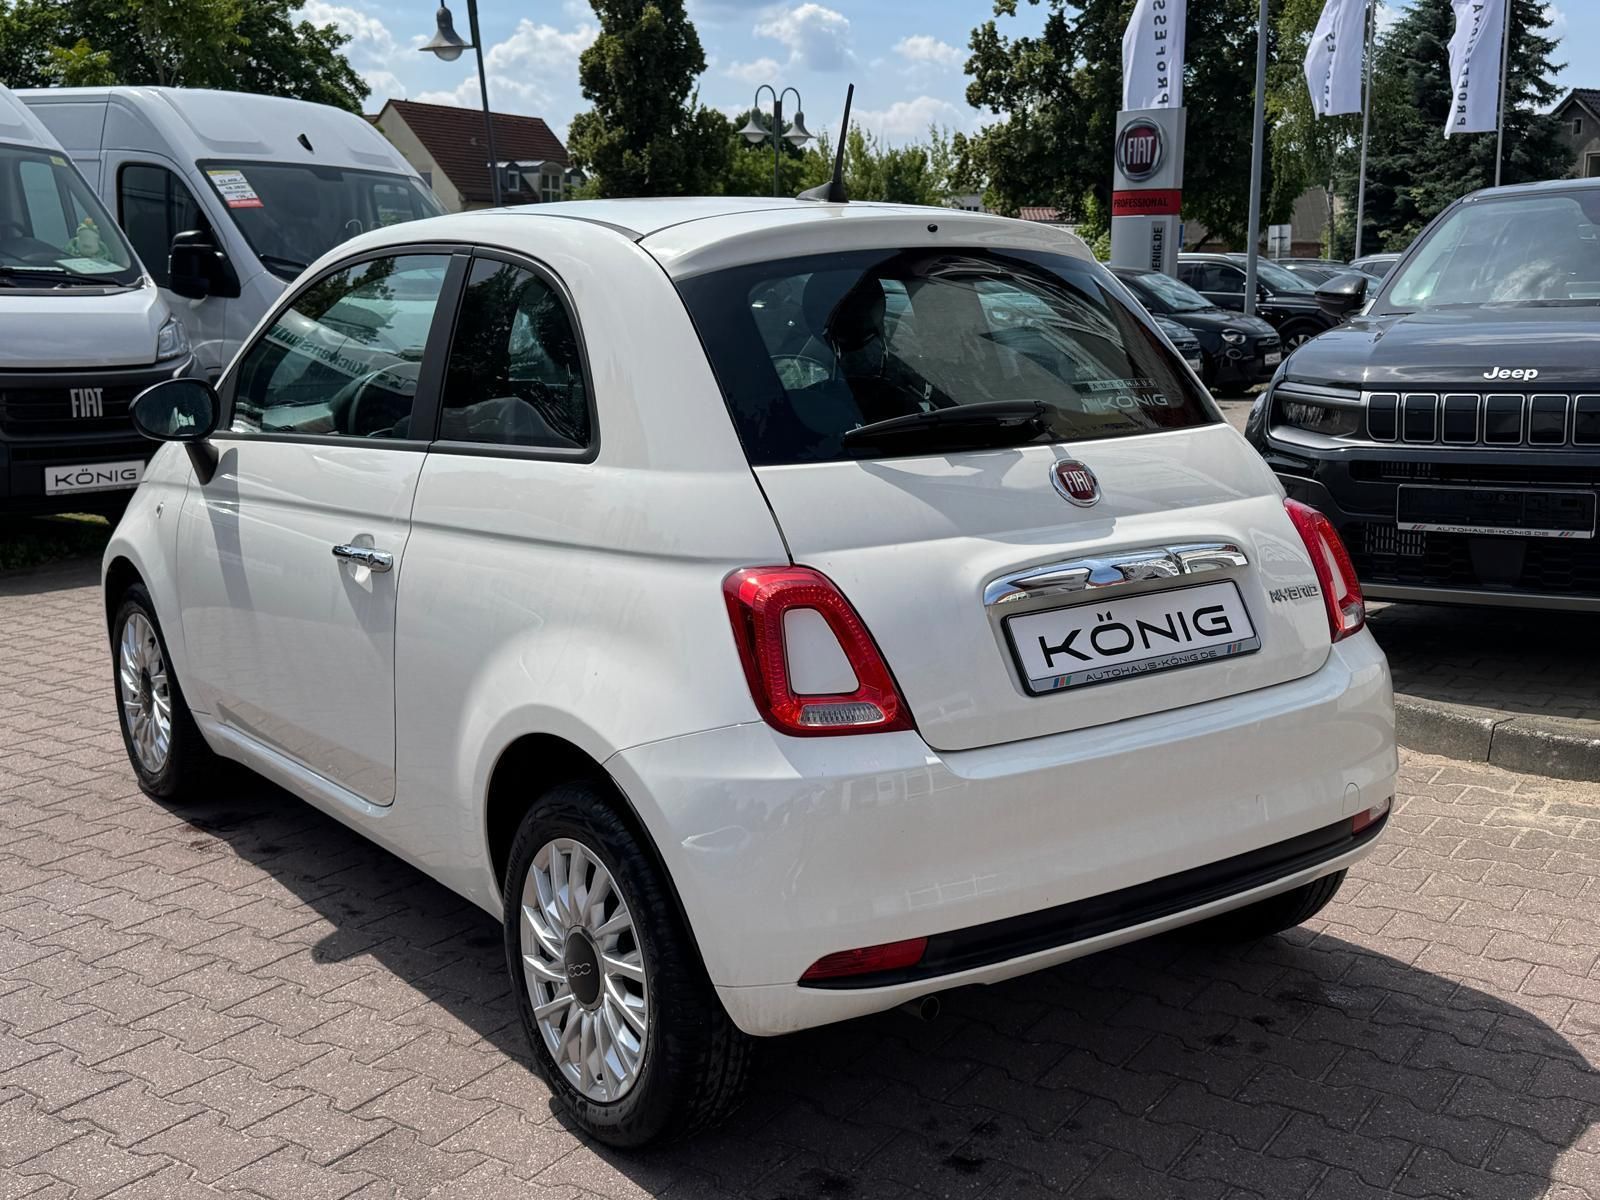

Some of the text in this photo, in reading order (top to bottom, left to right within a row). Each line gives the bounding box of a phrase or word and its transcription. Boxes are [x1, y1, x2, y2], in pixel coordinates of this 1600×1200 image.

[1127, 136, 1154, 166] FIAT
[1113, 198, 1168, 209] PROFESSIONAL
[1483, 366, 1538, 382] Jeep
[70, 388, 103, 418] FIAT
[1098, 391, 1168, 410] KÖNIG
[55, 468, 137, 487] KÖNIG
[1062, 470, 1092, 493] FIAT
[1269, 584, 1319, 604] HYBRID
[1038, 604, 1234, 669] KÖNIG
[567, 963, 592, 977] 500
